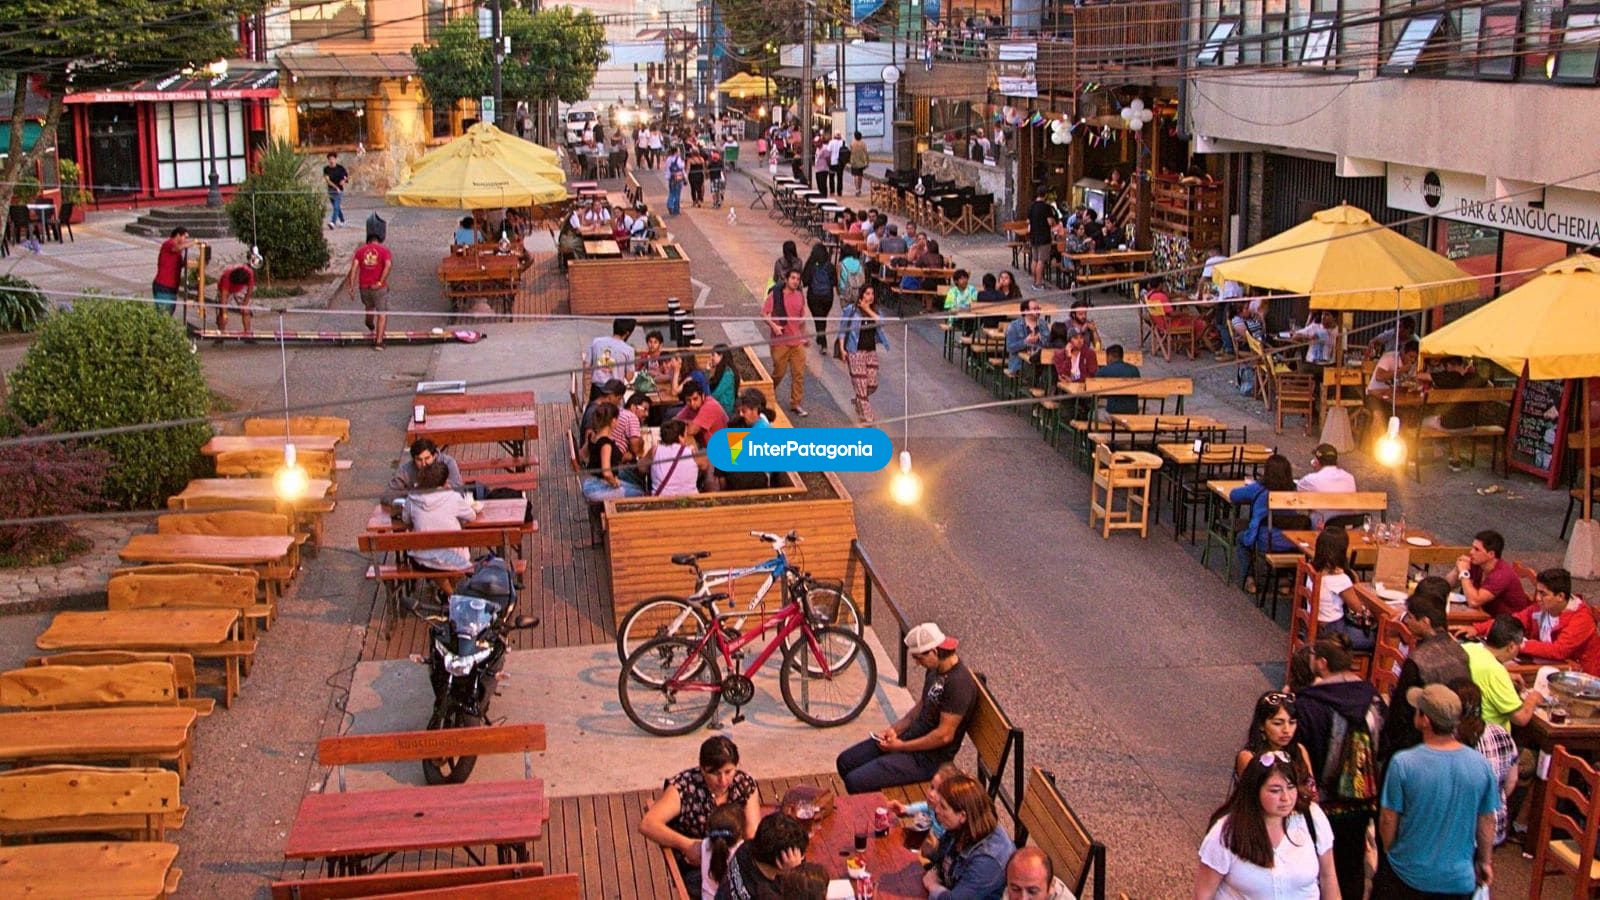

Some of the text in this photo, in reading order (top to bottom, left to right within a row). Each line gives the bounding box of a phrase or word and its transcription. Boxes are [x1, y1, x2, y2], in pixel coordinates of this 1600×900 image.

[1461, 198, 1600, 241] BAR & SANGUCHERIA
